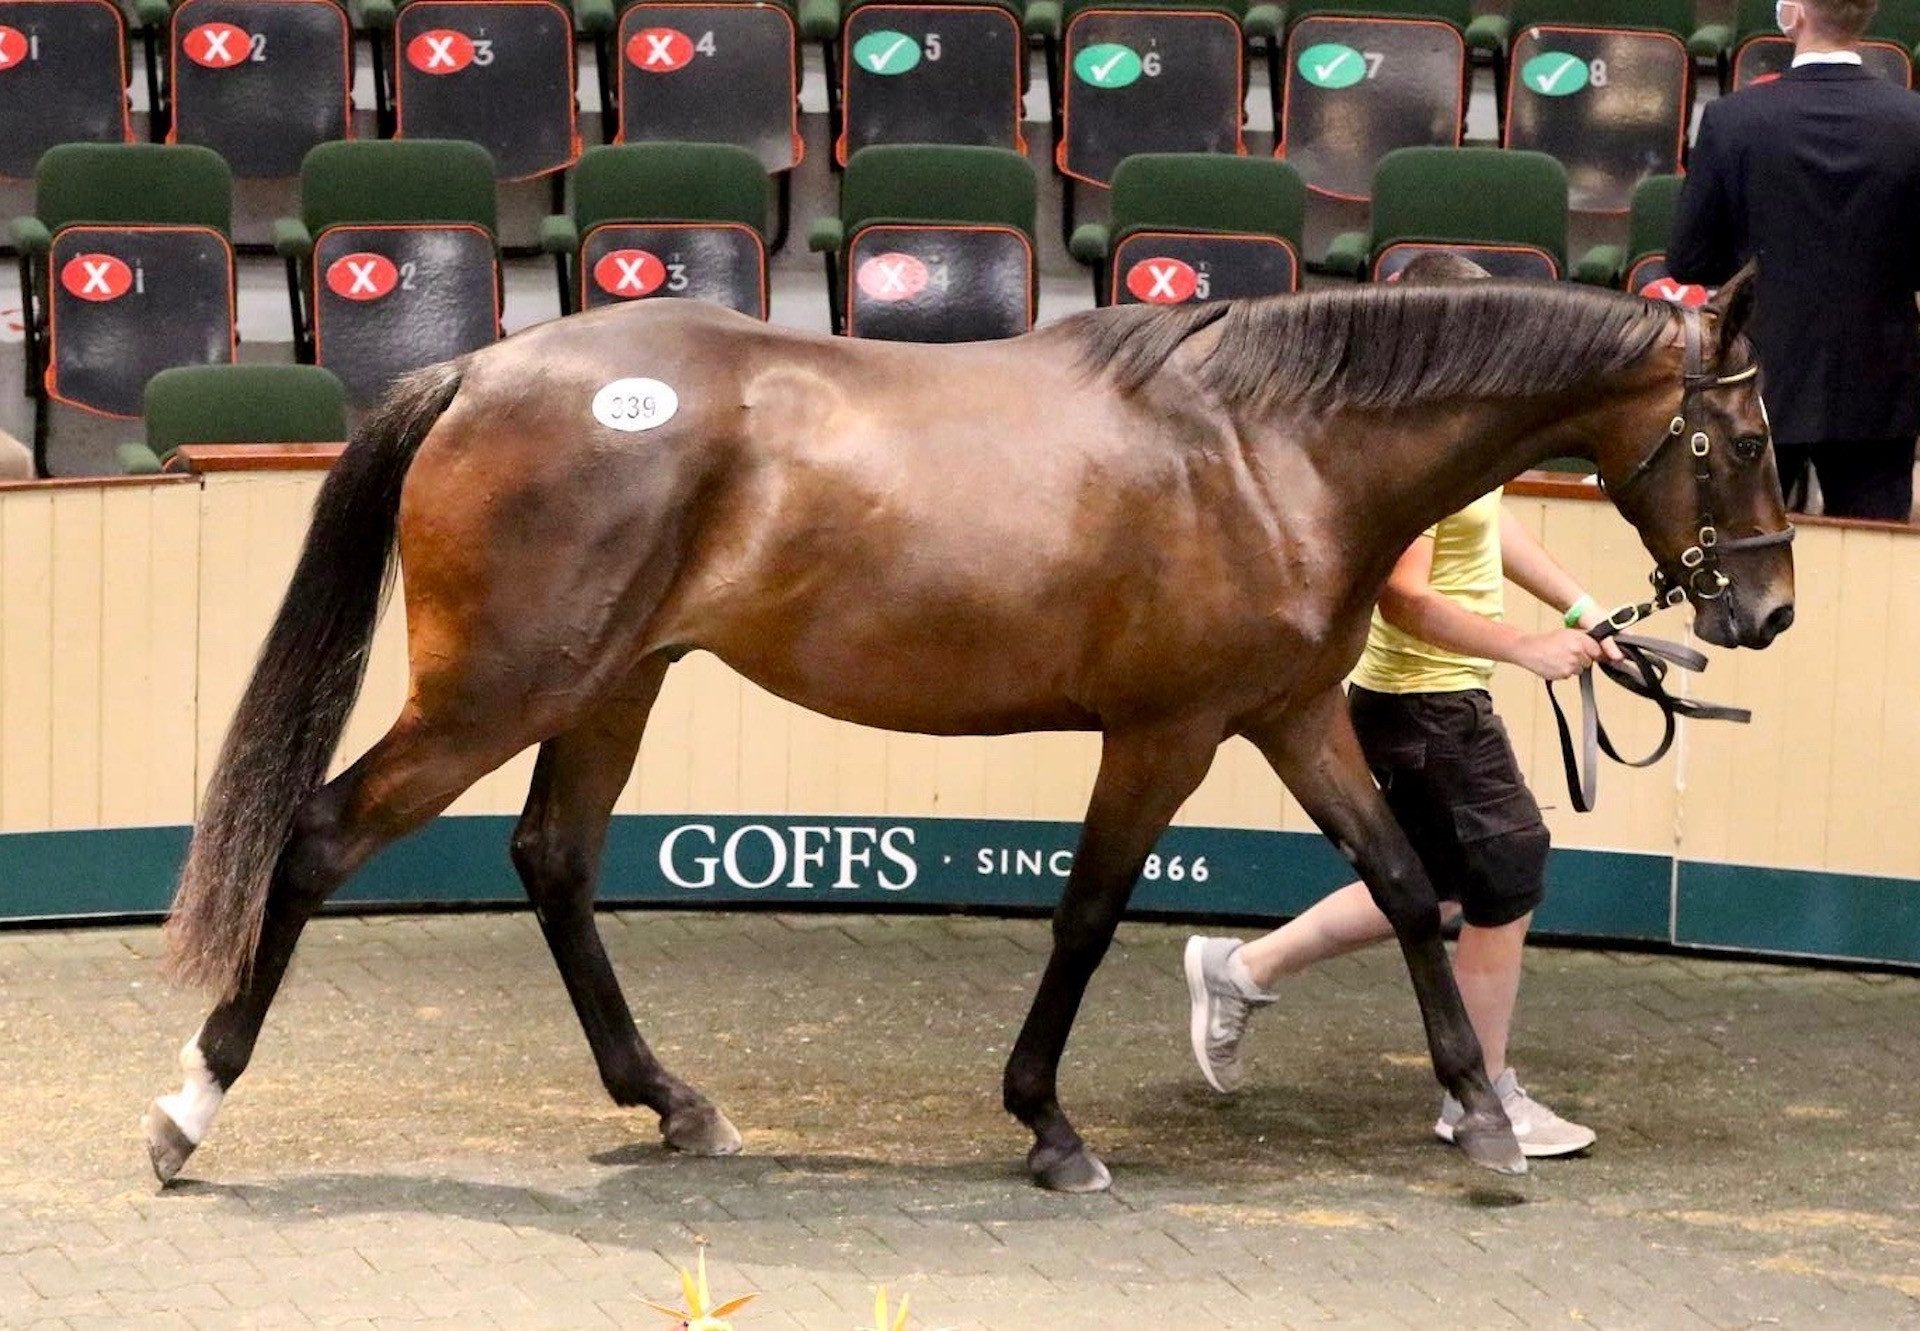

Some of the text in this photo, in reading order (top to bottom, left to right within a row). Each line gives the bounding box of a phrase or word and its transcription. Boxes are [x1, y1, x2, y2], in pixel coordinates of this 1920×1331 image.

[249, 34, 266, 62] 2
[473, 40, 494, 65] 3
[695, 31, 717, 56] 4
[925, 33, 942, 61] 5
[1142, 52, 1162, 77] 6
[1364, 53, 1384, 79] 7
[1589, 60, 1607, 87] 8
[399, 265, 417, 290] 2
[665, 264, 689, 290] 3
[1194, 275, 1210, 298] 5
[611, 396, 656, 419] 339
[659, 823, 1209, 890] GOFFS SINC 866
